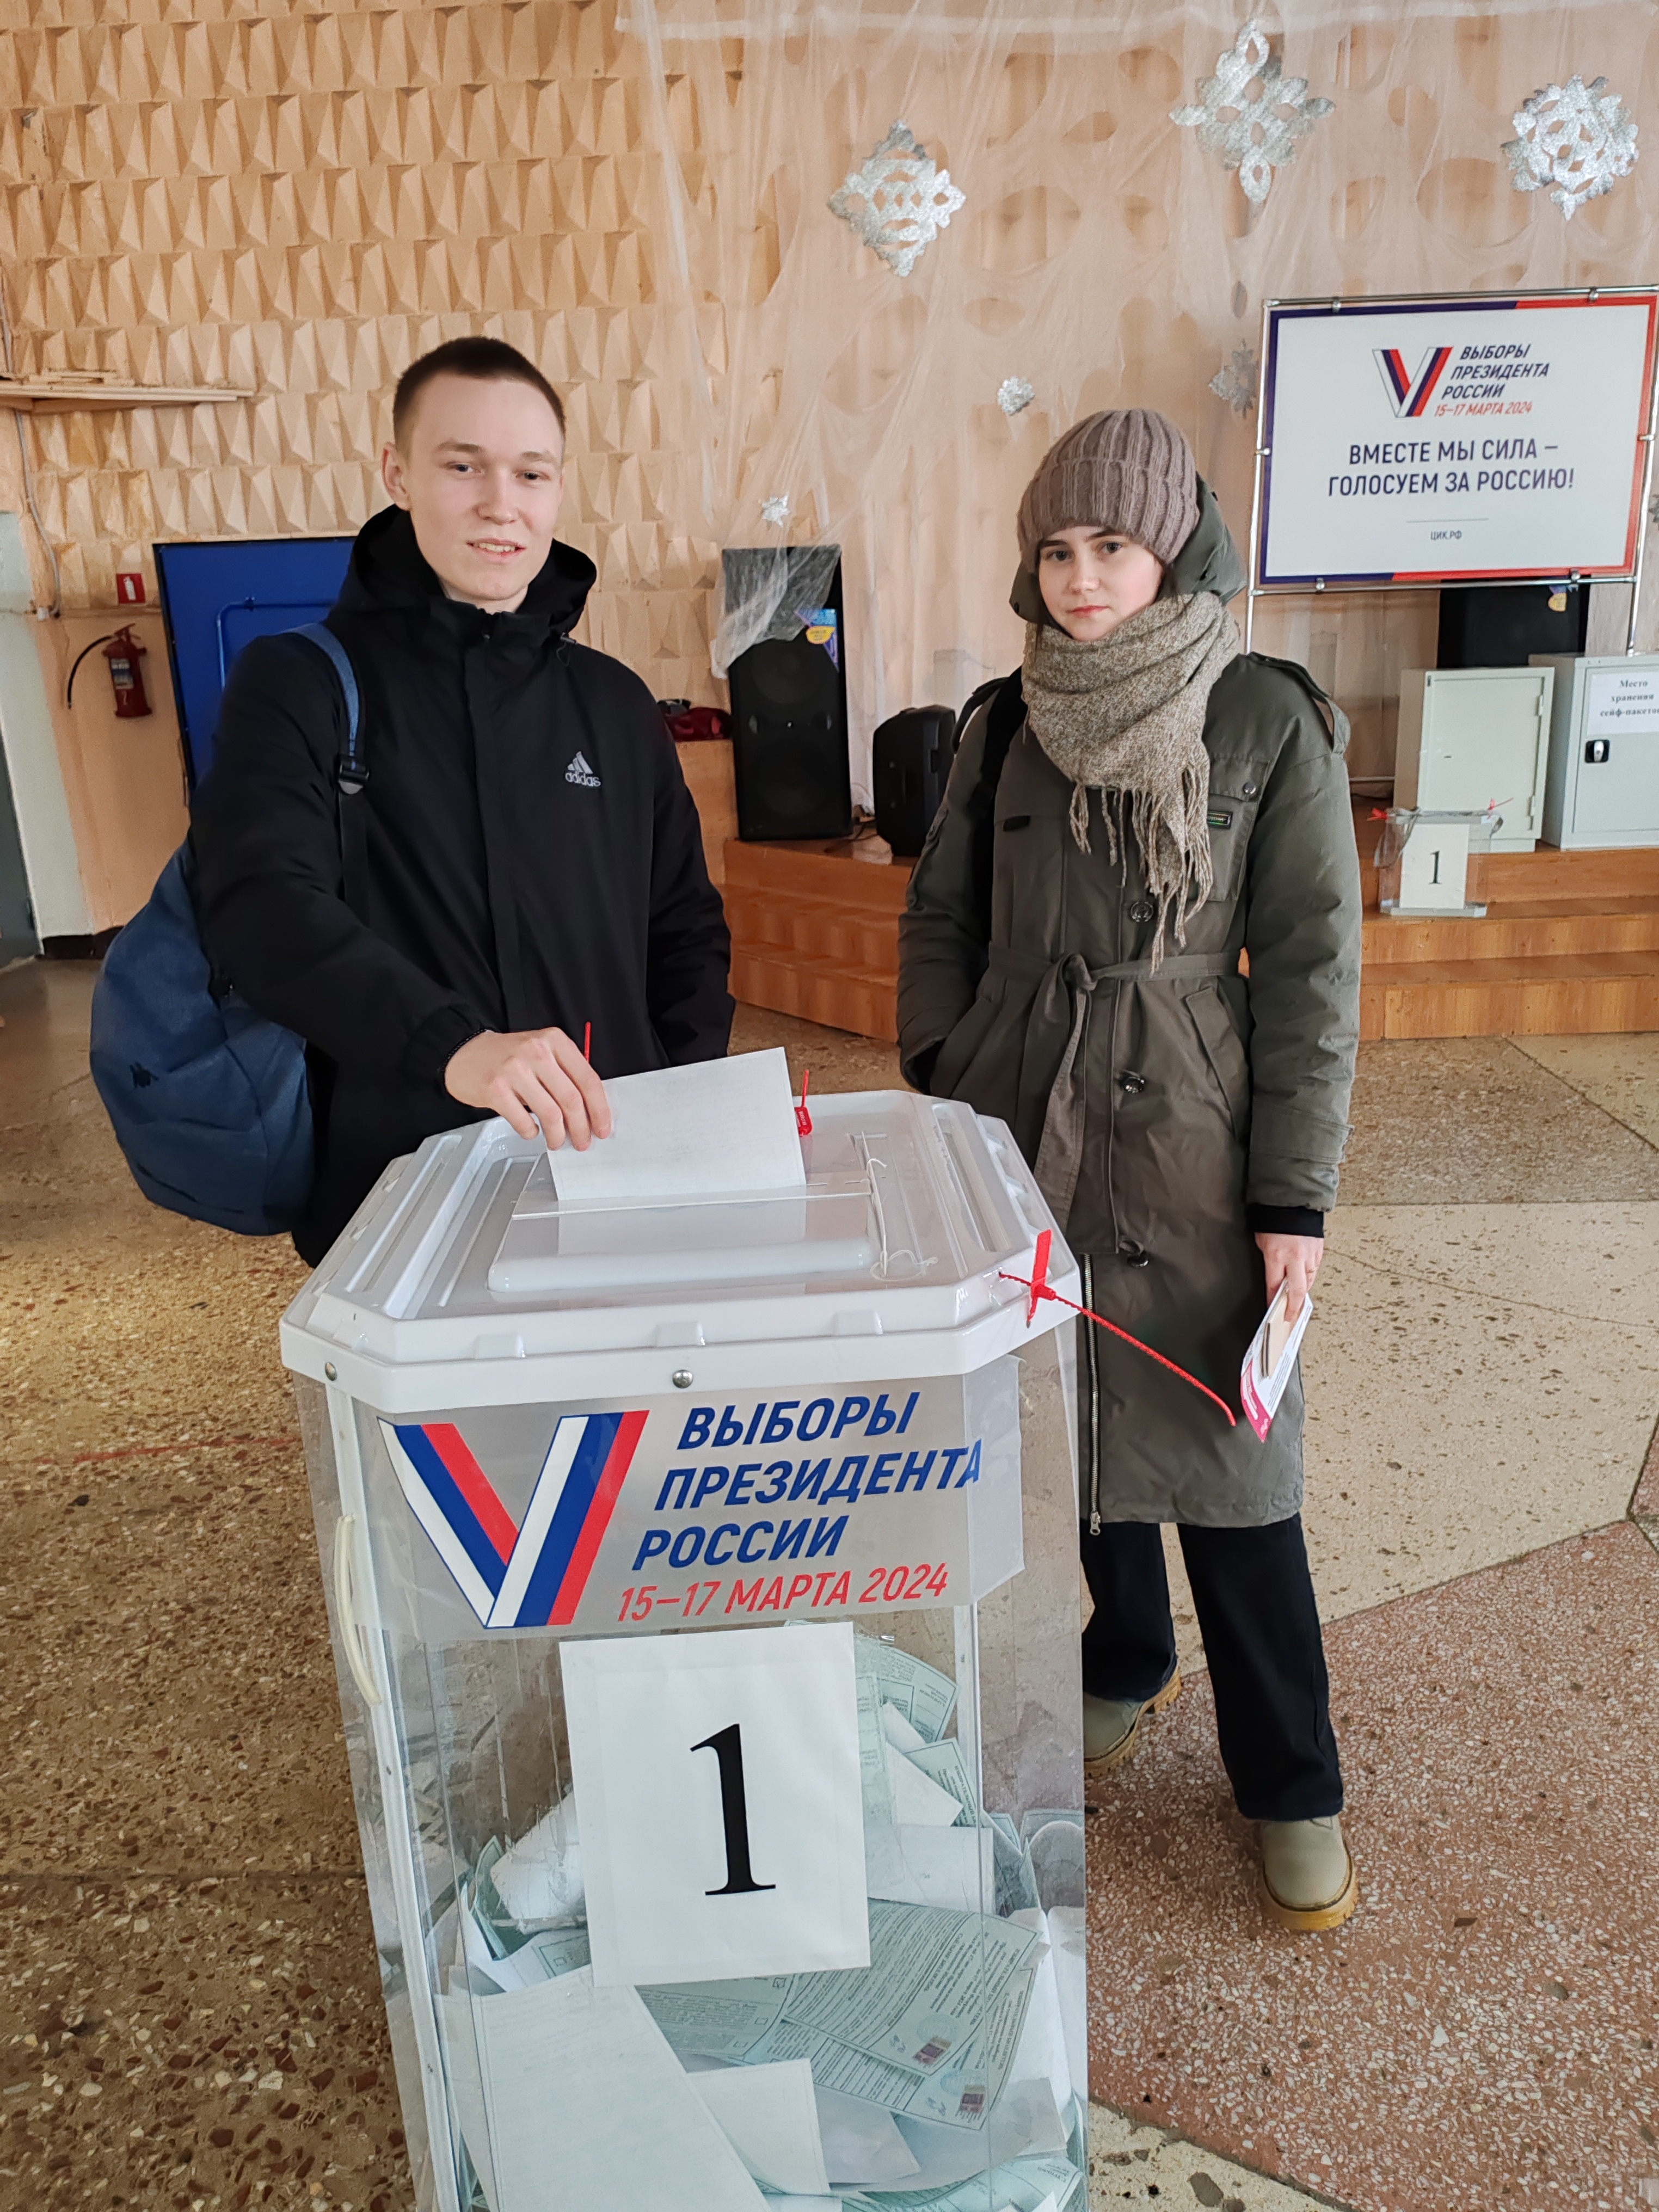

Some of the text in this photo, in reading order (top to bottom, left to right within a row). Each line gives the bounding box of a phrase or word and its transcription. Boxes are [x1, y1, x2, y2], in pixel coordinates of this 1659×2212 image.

[1459, 344, 1531, 360] ВЫБОРЫ
[1450, 363, 1550, 380] ПРЕЗИДЕНТА
[1441, 384, 1506, 400] РОССИИ
[1466, 402, 1504, 416] МАРТА
[1505, 401, 1532, 414] 2024
[1349, 442, 1431, 465] ВМЕСТЕ
[1437, 440, 1475, 462] МЫ
[1482, 438, 1538, 460] СИЛА
[1329, 468, 1574, 496] ГОЛОСУЕМ ЗА РОССИЮ!
[1620, 679, 1648, 688] Место
[1611, 694, 1654, 704] хранения
[565, 771, 601, 787] adidas
[1428, 850, 1442, 884] 1
[678, 1392, 920, 1450] ВЫБОРЫ
[655, 1439, 982, 1511] ПРЕЗИДЕНТА
[632, 1515, 849, 1571] РОССИИ
[724, 1570, 852, 1614] МАРТА
[858, 1563, 949, 1603] 2024
[690, 1723, 776, 1896] 1
